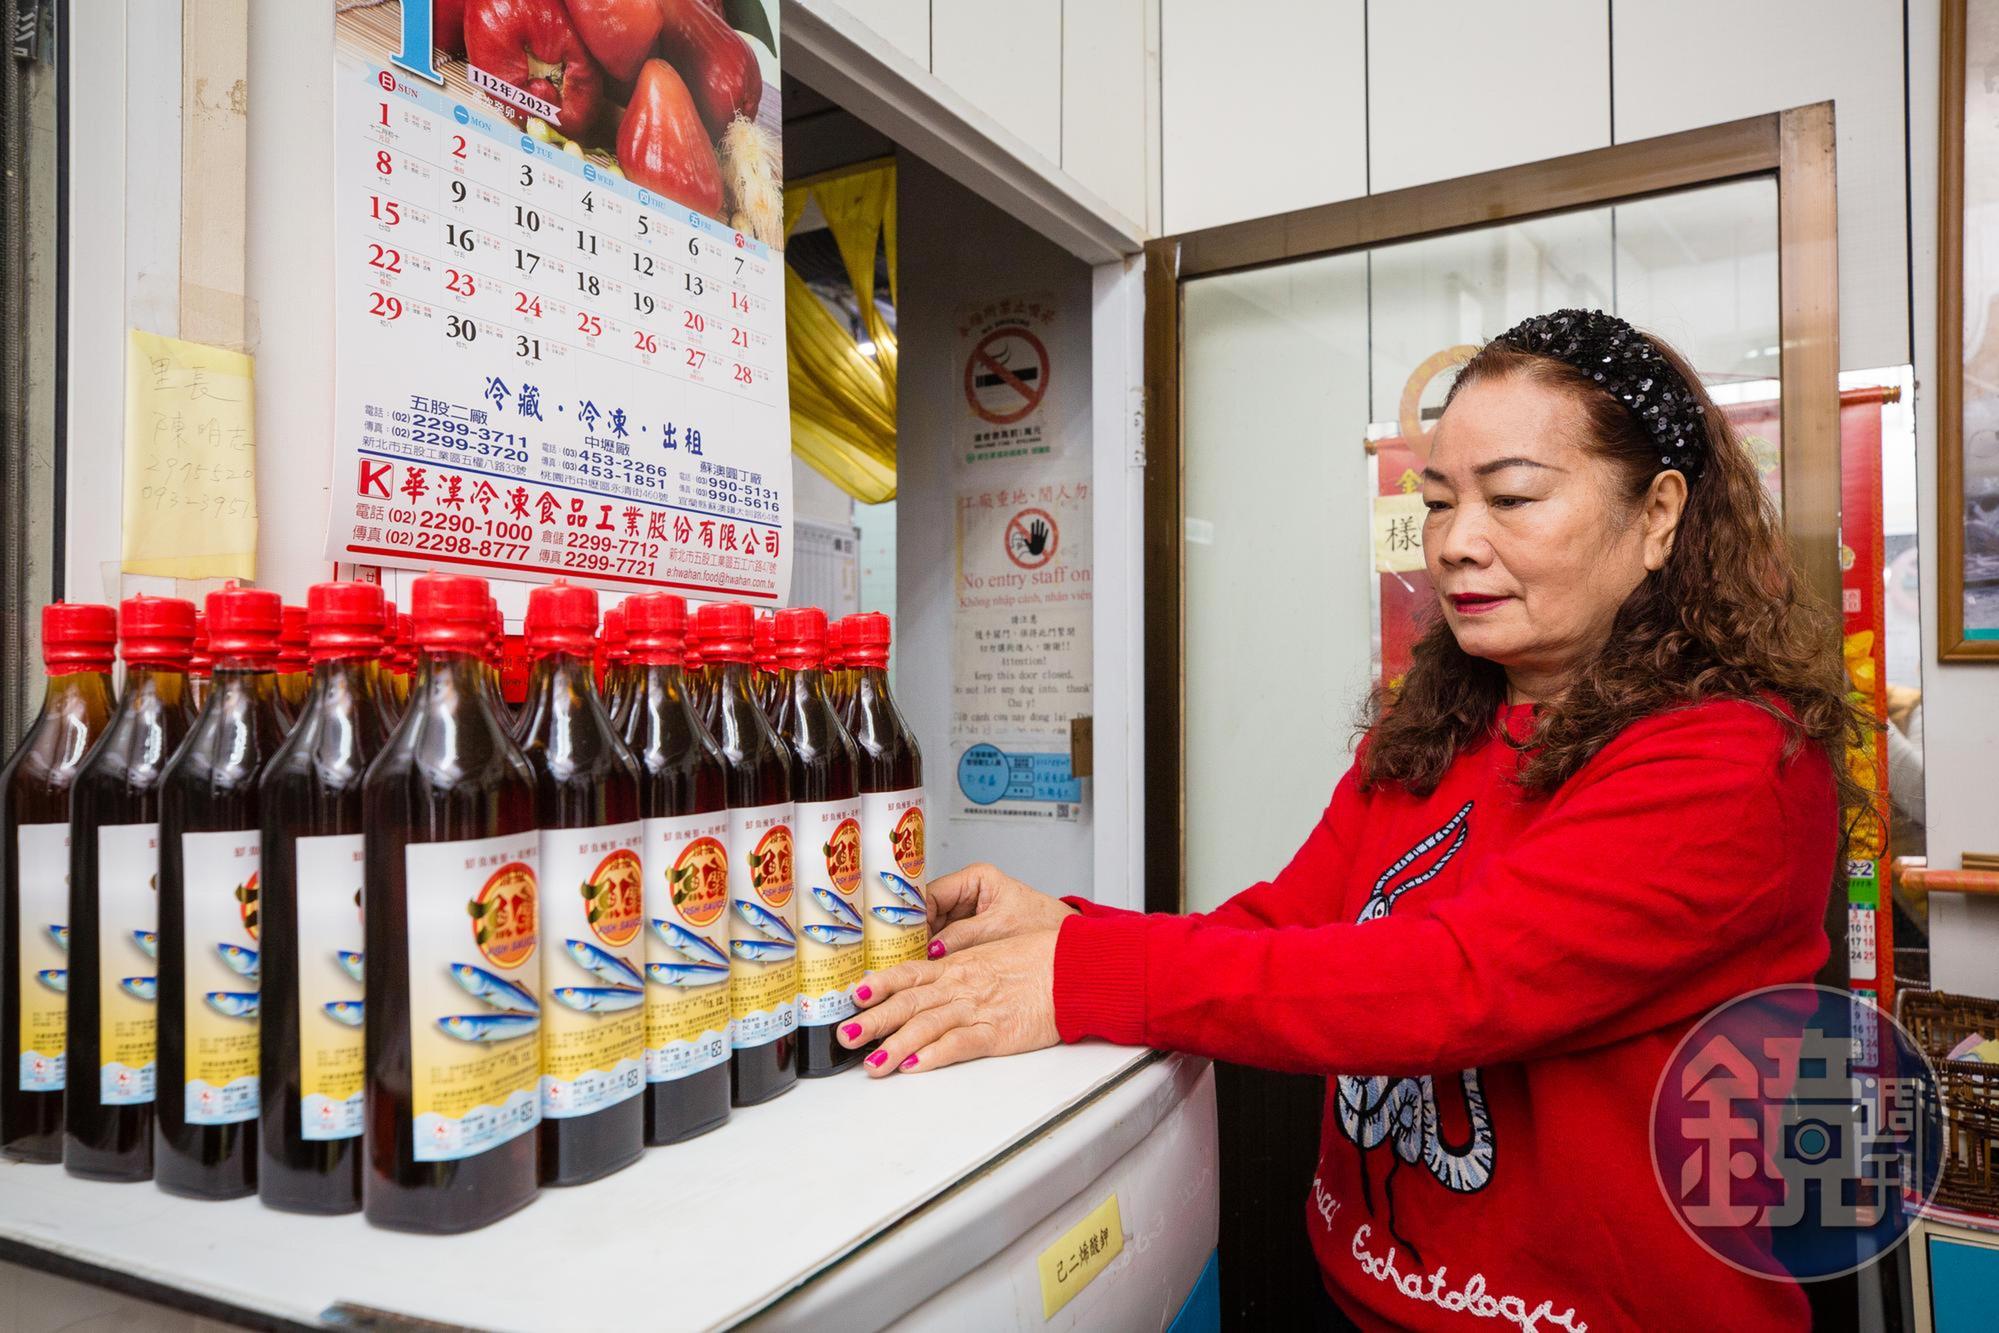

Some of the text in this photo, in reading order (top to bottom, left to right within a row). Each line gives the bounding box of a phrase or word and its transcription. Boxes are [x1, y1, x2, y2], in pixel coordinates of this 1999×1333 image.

[398, 83, 418, 99] SUN
[473, 70, 552, 118] 112年/2023
[379, 102, 391, 128] 1
[470, 116, 492, 132] MON
[451, 135, 467, 160] 2
[536, 147, 554, 161] TUE
[376, 150, 393, 175] 8
[519, 164, 534, 187] 3
[451, 180, 467, 203] 9
[581, 190, 595, 213] 4
[370, 195, 400, 226] 15
[514, 205, 540, 232] 10
[638, 215, 649, 235] 5
[446, 224, 475, 252] 16
[576, 230, 598, 256] 11
[688, 237, 699, 256] 6
[368, 243, 402, 274] 22
[515, 249, 541, 275] 17
[633, 252, 654, 277] 12
[734, 256, 745, 275] 7
[445, 269, 476, 297] 23
[577, 271, 601, 296] 18
[685, 273, 704, 296] 13
[369, 291, 403, 321] 29
[515, 291, 543, 318] 24
[633, 292, 655, 315] 19
[732, 292, 749, 313] 14
[446, 314, 477, 342] 30
[577, 312, 602, 337] 25
[684, 310, 705, 333] 20
[516, 335, 542, 361] 31
[634, 330, 657, 354] 26
[731, 327, 748, 348] 21
[686, 348, 706, 370] 27
[734, 363, 753, 384] 28
[410, 394, 488, 426] 五股二廠
[392, 411, 411, 424] (02)
[413, 414, 528, 449] 2299-3711
[391, 425, 411, 439] (02)
[412, 429, 529, 463] 2299-3720
[584, 435, 630, 457] 中壢廠
[562, 447, 578, 459] (03)
[578, 449, 667, 477] 453-2266
[562, 461, 578, 472] (03)
[578, 462, 666, 490] 453-1851
[695, 476, 708, 485] (03)
[708, 477, 779, 501] 990-5131
[695, 487, 708, 497] (03)
[708, 488, 780, 512] 990-5616
[355, 502, 533, 542] 電話 (02) 2290-1000
[361, 460, 780, 559] K 華漢冷凍食品工業股份有限公司
[352, 525, 531, 562] 傳真 (02) 2298-8777
[541, 529, 659, 560] 倉儲 2299-7712
[1385, 516, 1422, 552] 樣
[539, 549, 656, 578] 傳真 2299-7721
[963, 574, 984, 589] No
[988, 573, 1026, 590] entry
[1032, 566, 1069, 585] staff
[974, 671, 993, 682] Keep
[997, 671, 1015, 680] this
[1019, 671, 1038, 680] door
[683, 905, 700, 915] FISH
[1850, 925, 1861, 933] 10
[1850, 938, 1861, 946] 17
[1850, 951, 1862, 960] 24
